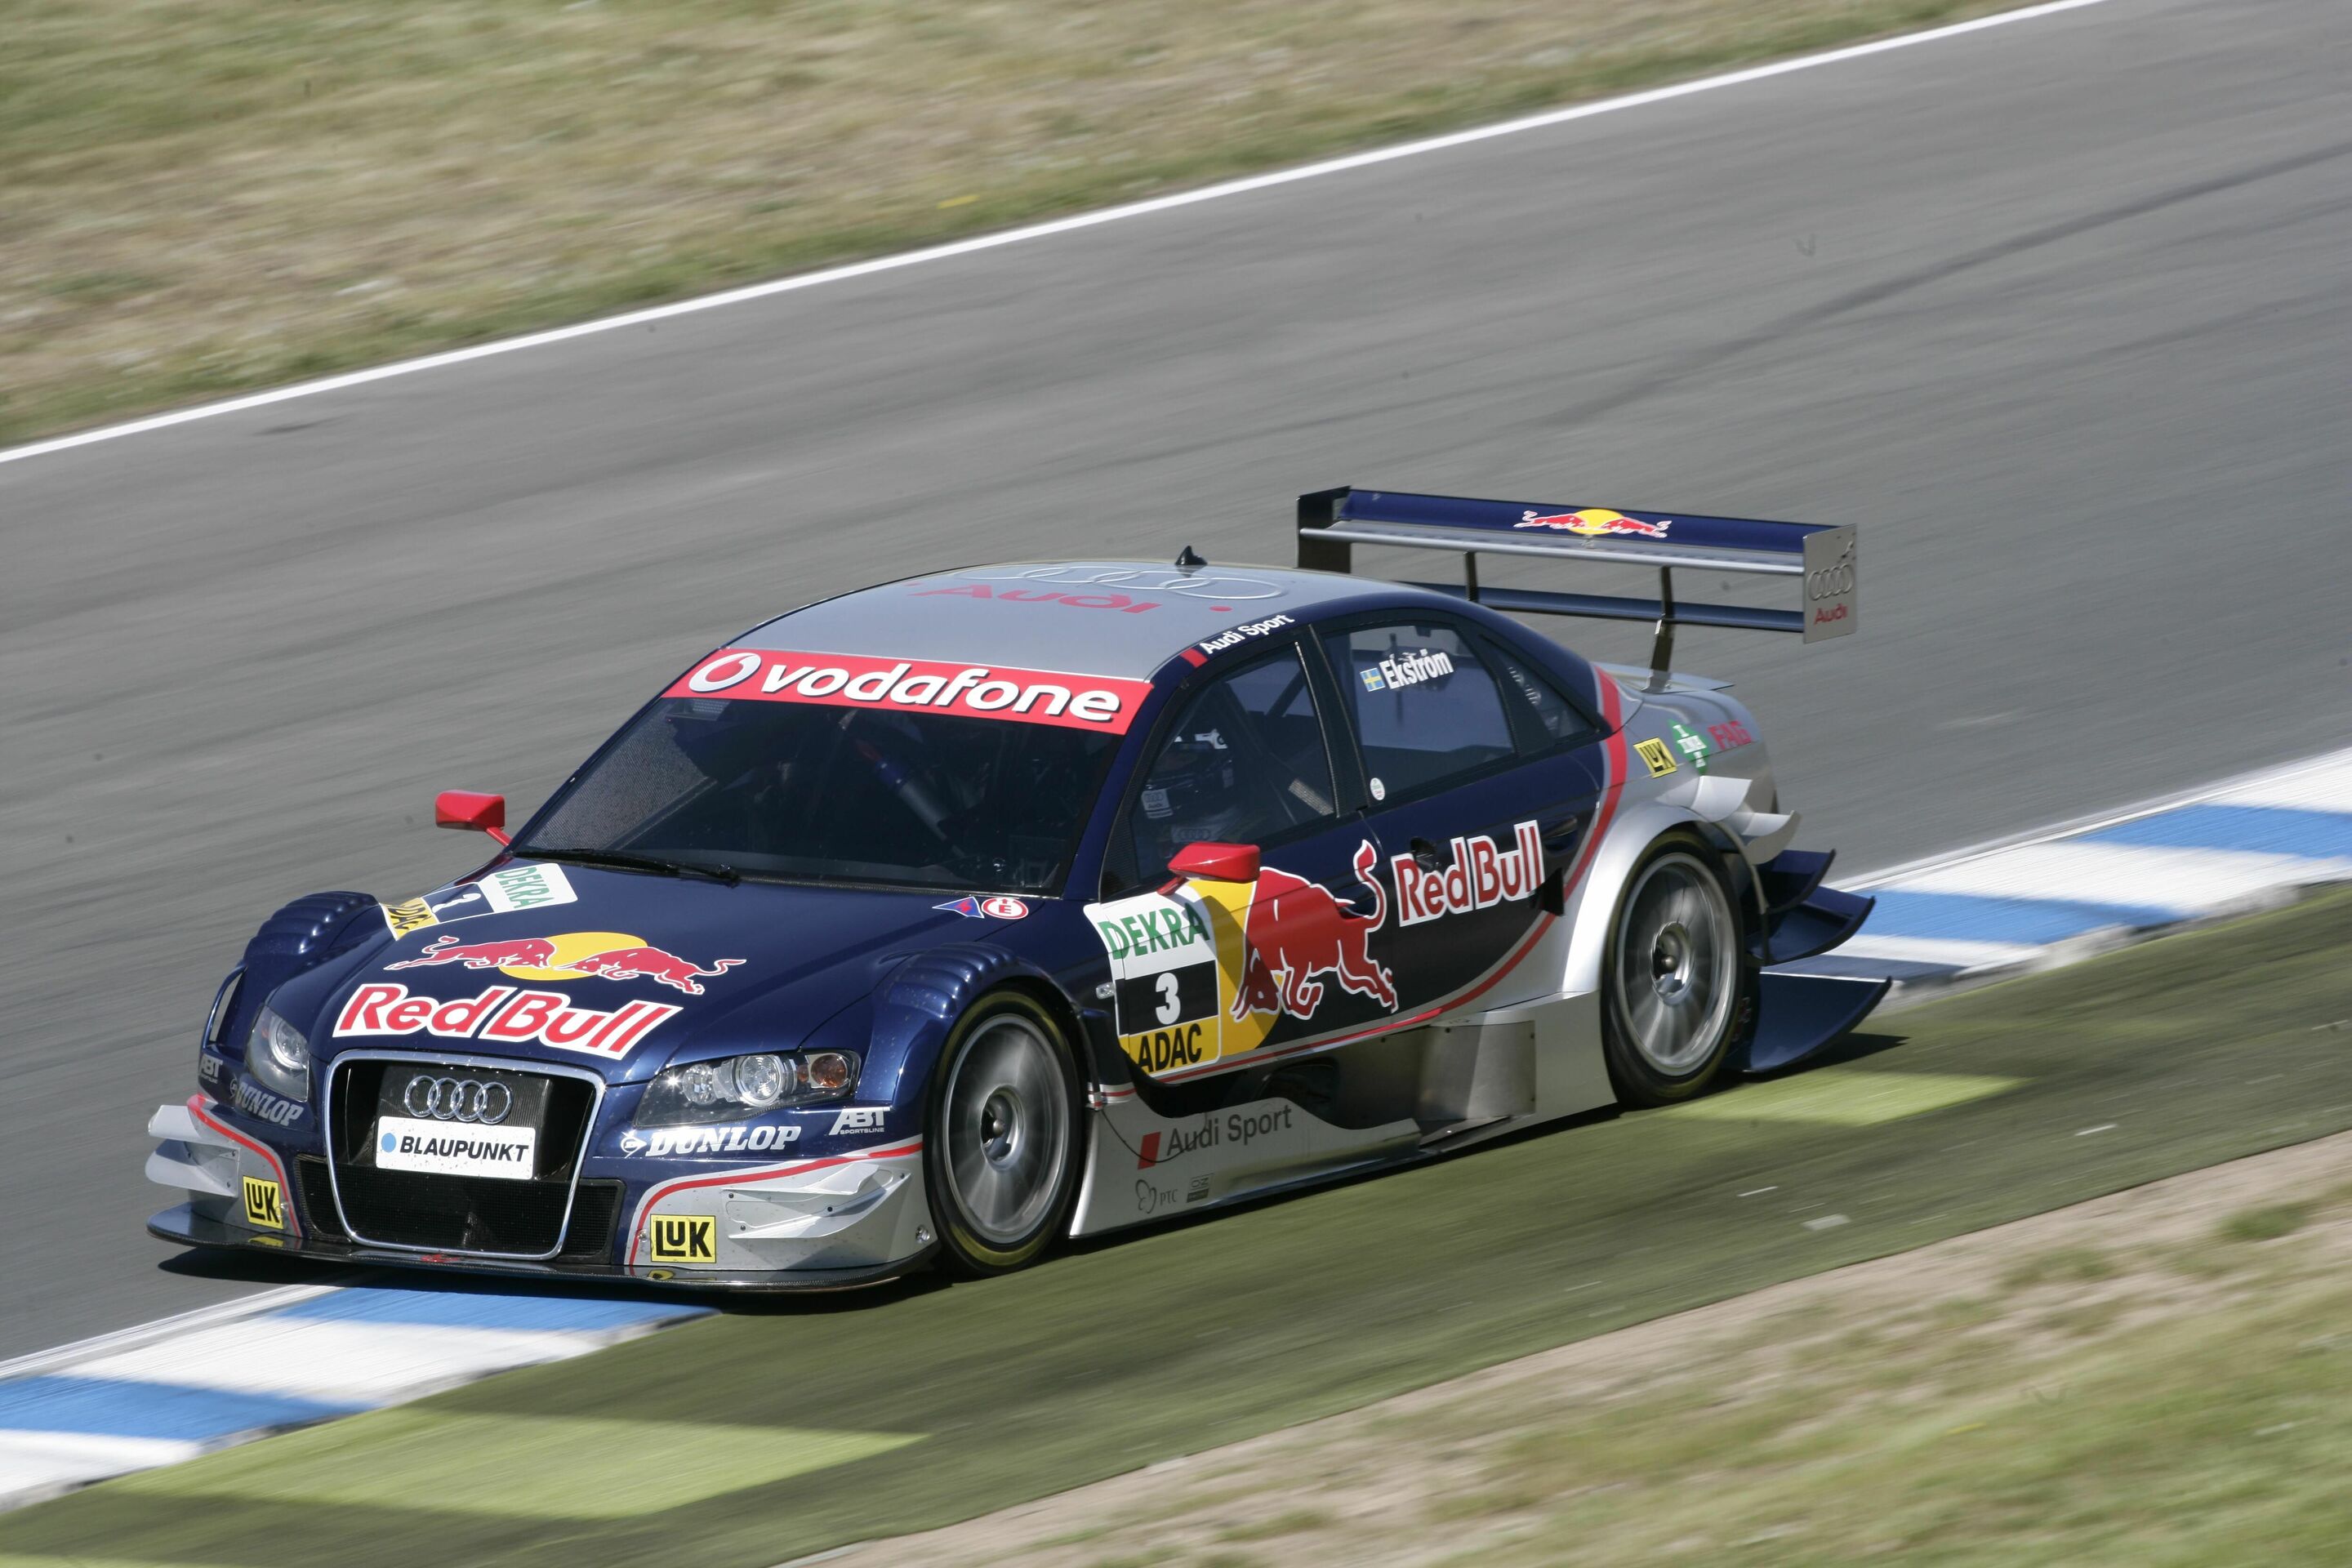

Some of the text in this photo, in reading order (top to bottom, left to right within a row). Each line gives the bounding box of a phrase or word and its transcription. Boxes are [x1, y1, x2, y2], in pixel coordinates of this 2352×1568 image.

[909, 584, 1162, 614] Audi
[1814, 604, 1848, 626] Audi
[1200, 614, 1295, 654] Audi Sport
[1379, 648, 1454, 689] Ekström
[761, 663, 1120, 723] vodafone
[494, 866, 555, 909] DEKRA
[1392, 820, 1544, 926] Red Bull
[1096, 902, 1210, 960] DEKRA
[1155, 972, 1181, 1026] 3
[336, 984, 681, 1059] Red Bull
[1136, 1025, 1203, 1074] ADAC
[236, 1082, 304, 1126] DUNLOP
[828, 1107, 891, 1136] ABT
[399, 1135, 529, 1162] BLAUPUNKT
[645, 1125, 802, 1157] DUNLOP
[840, 1127, 885, 1135] SPORTSLINE
[1166, 1104, 1292, 1156] Audi Sport
[246, 1181, 280, 1223] LUK
[1160, 1188, 1178, 1206] PTC
[657, 1221, 712, 1258] LUK
